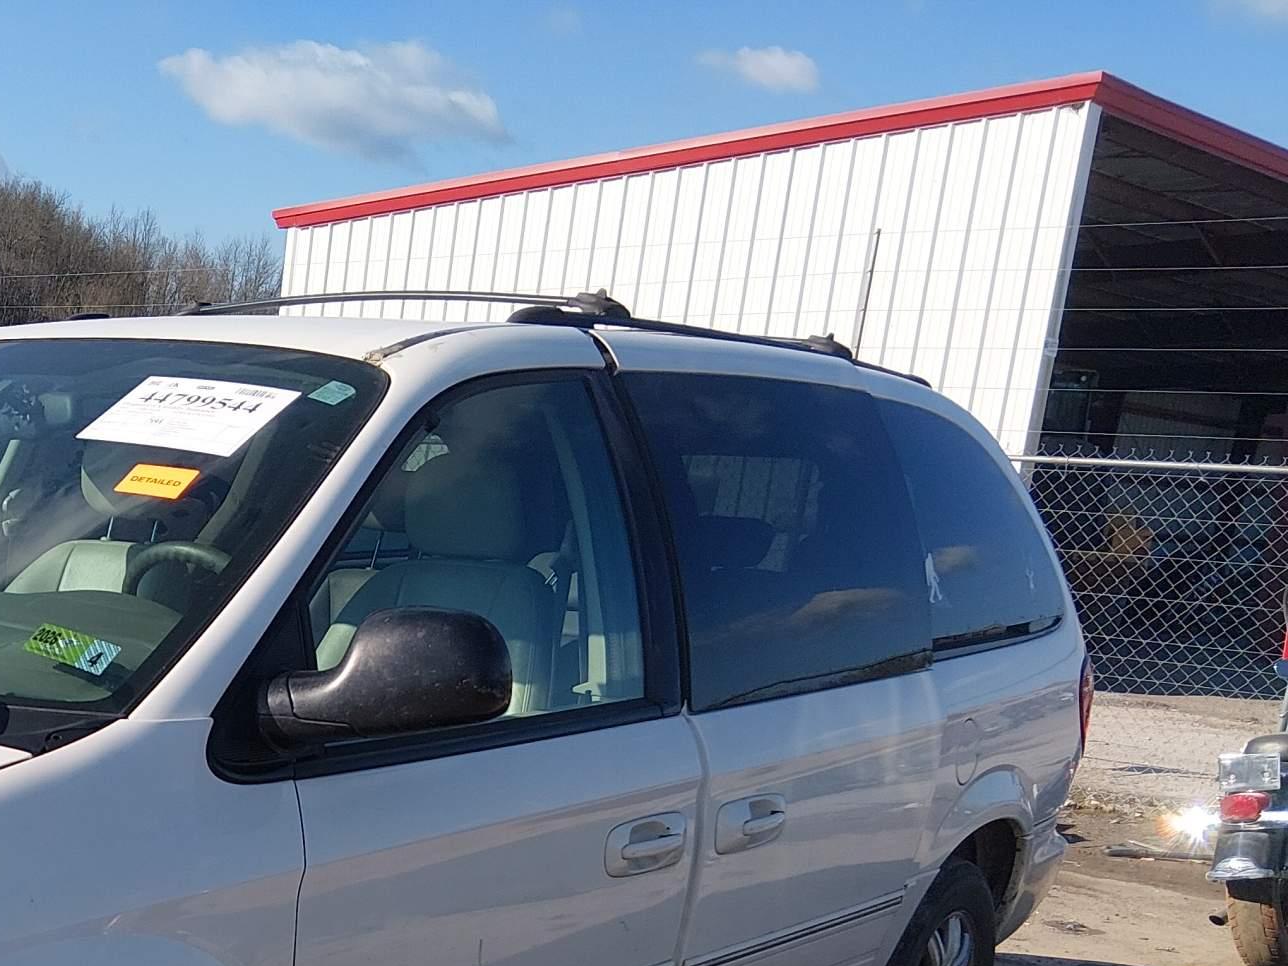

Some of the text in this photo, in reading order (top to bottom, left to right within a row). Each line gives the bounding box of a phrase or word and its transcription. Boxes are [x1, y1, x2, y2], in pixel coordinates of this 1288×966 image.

[139, 391, 263, 414] 44799544
[129, 475, 182, 487] DETAILED
[31, 627, 62, 646] 2026
[87, 651, 104, 668] 4
